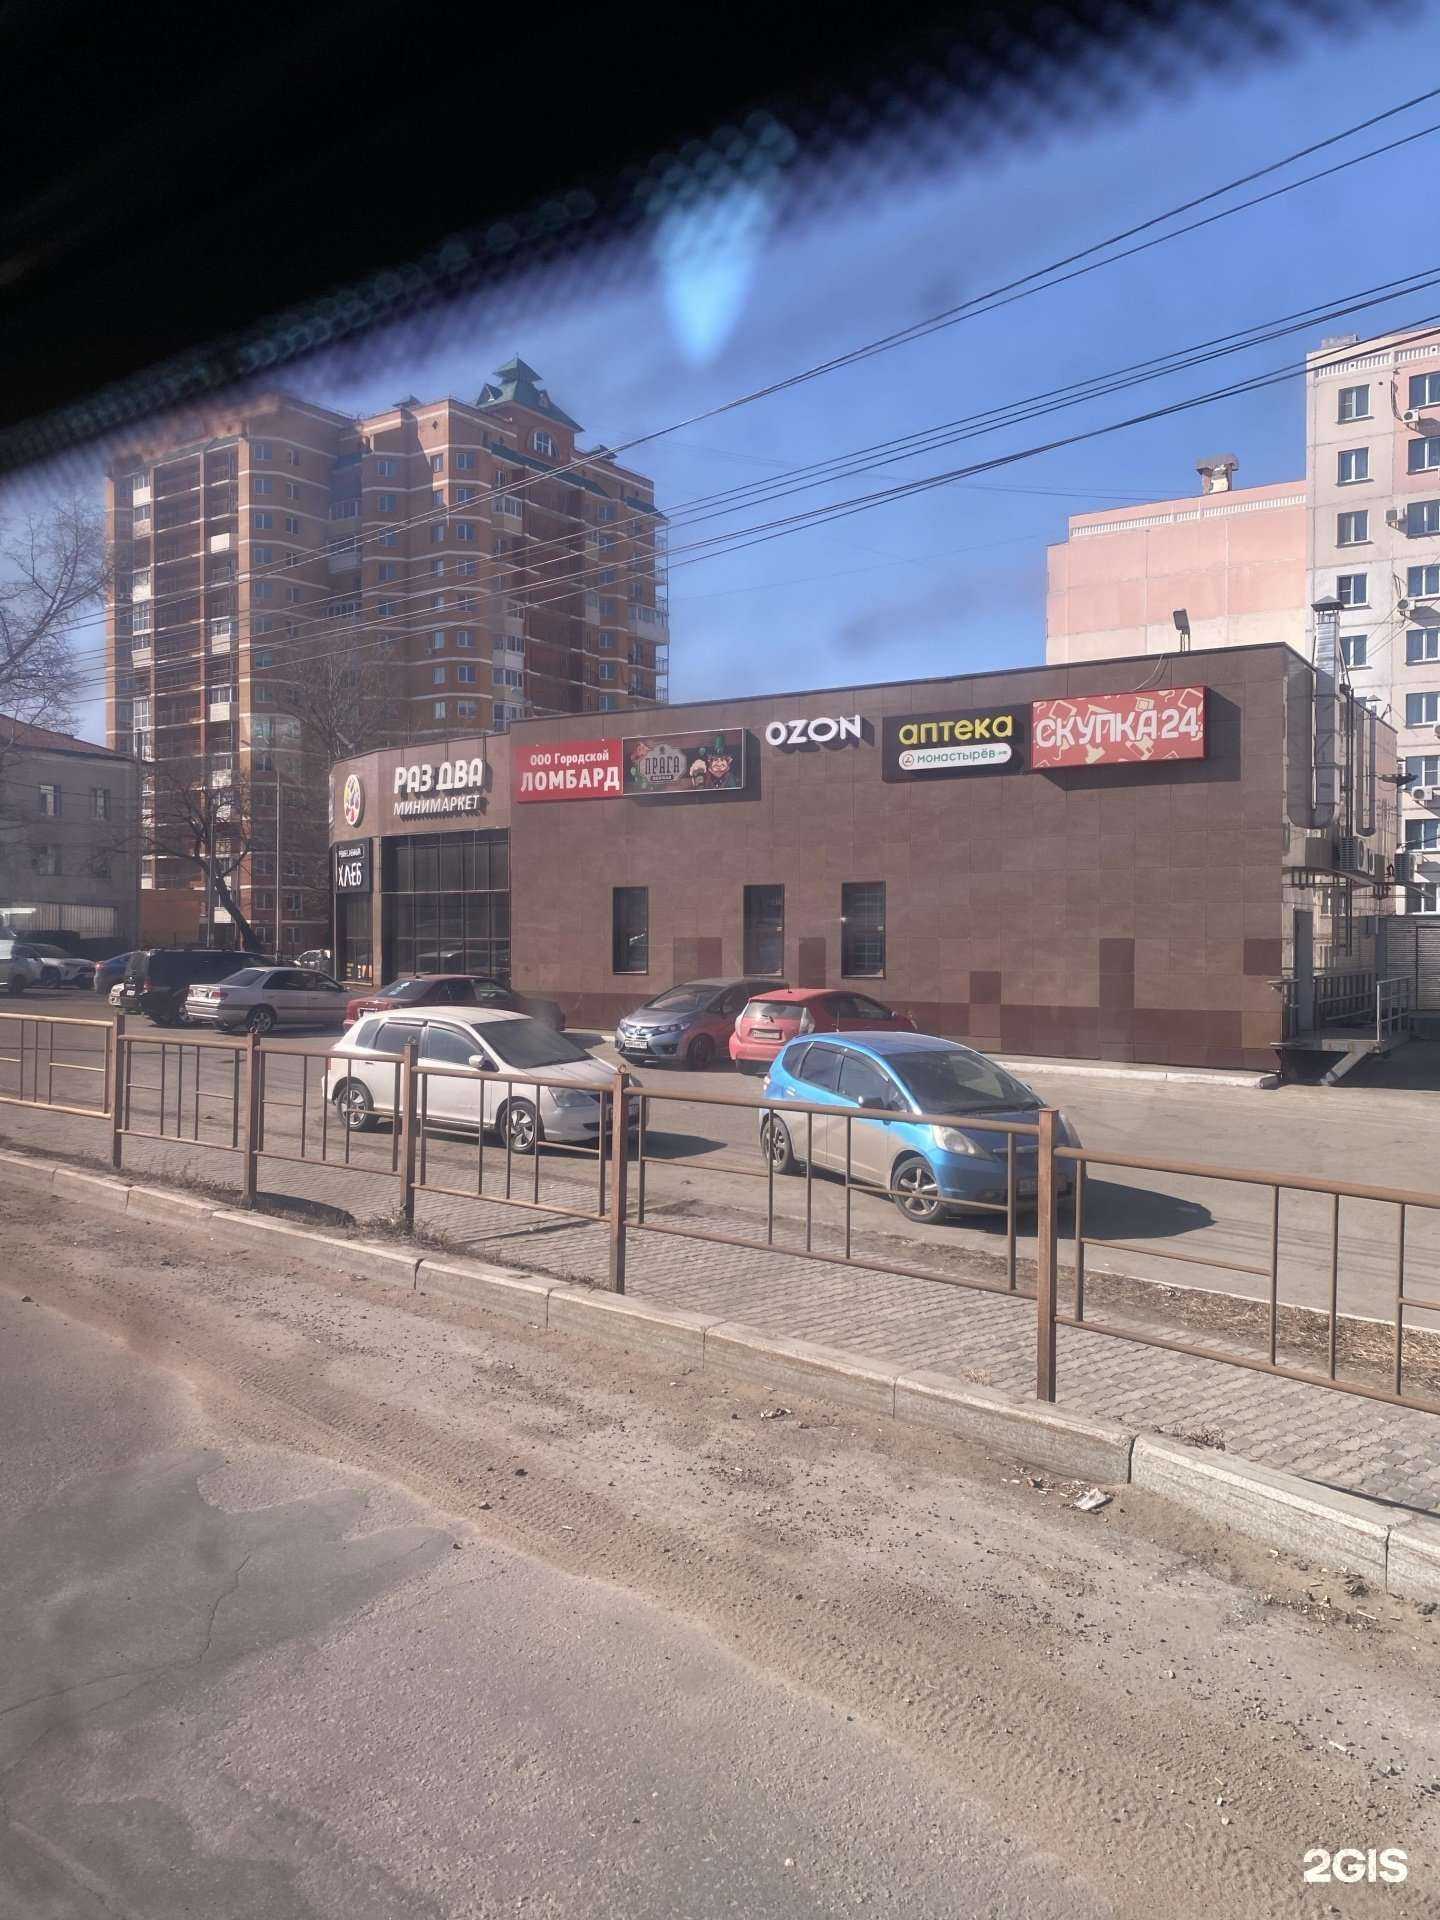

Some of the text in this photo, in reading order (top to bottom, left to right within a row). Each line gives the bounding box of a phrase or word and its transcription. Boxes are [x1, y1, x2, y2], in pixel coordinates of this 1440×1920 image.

[765, 715, 862, 746] OZON
[899, 714, 1013, 745] аптека
[530, 749, 609, 766] ООО Городской
[645, 755, 680, 776] ПРАГА
[917, 748, 996, 764] монастырёв
[394, 758, 483, 794] РАЗ ДВА
[520, 766, 620, 792] ЛОМБАРД
[393, 795, 480, 816] МИНИМАРКЕТ
[338, 862, 362, 887] ХЛЕБ
